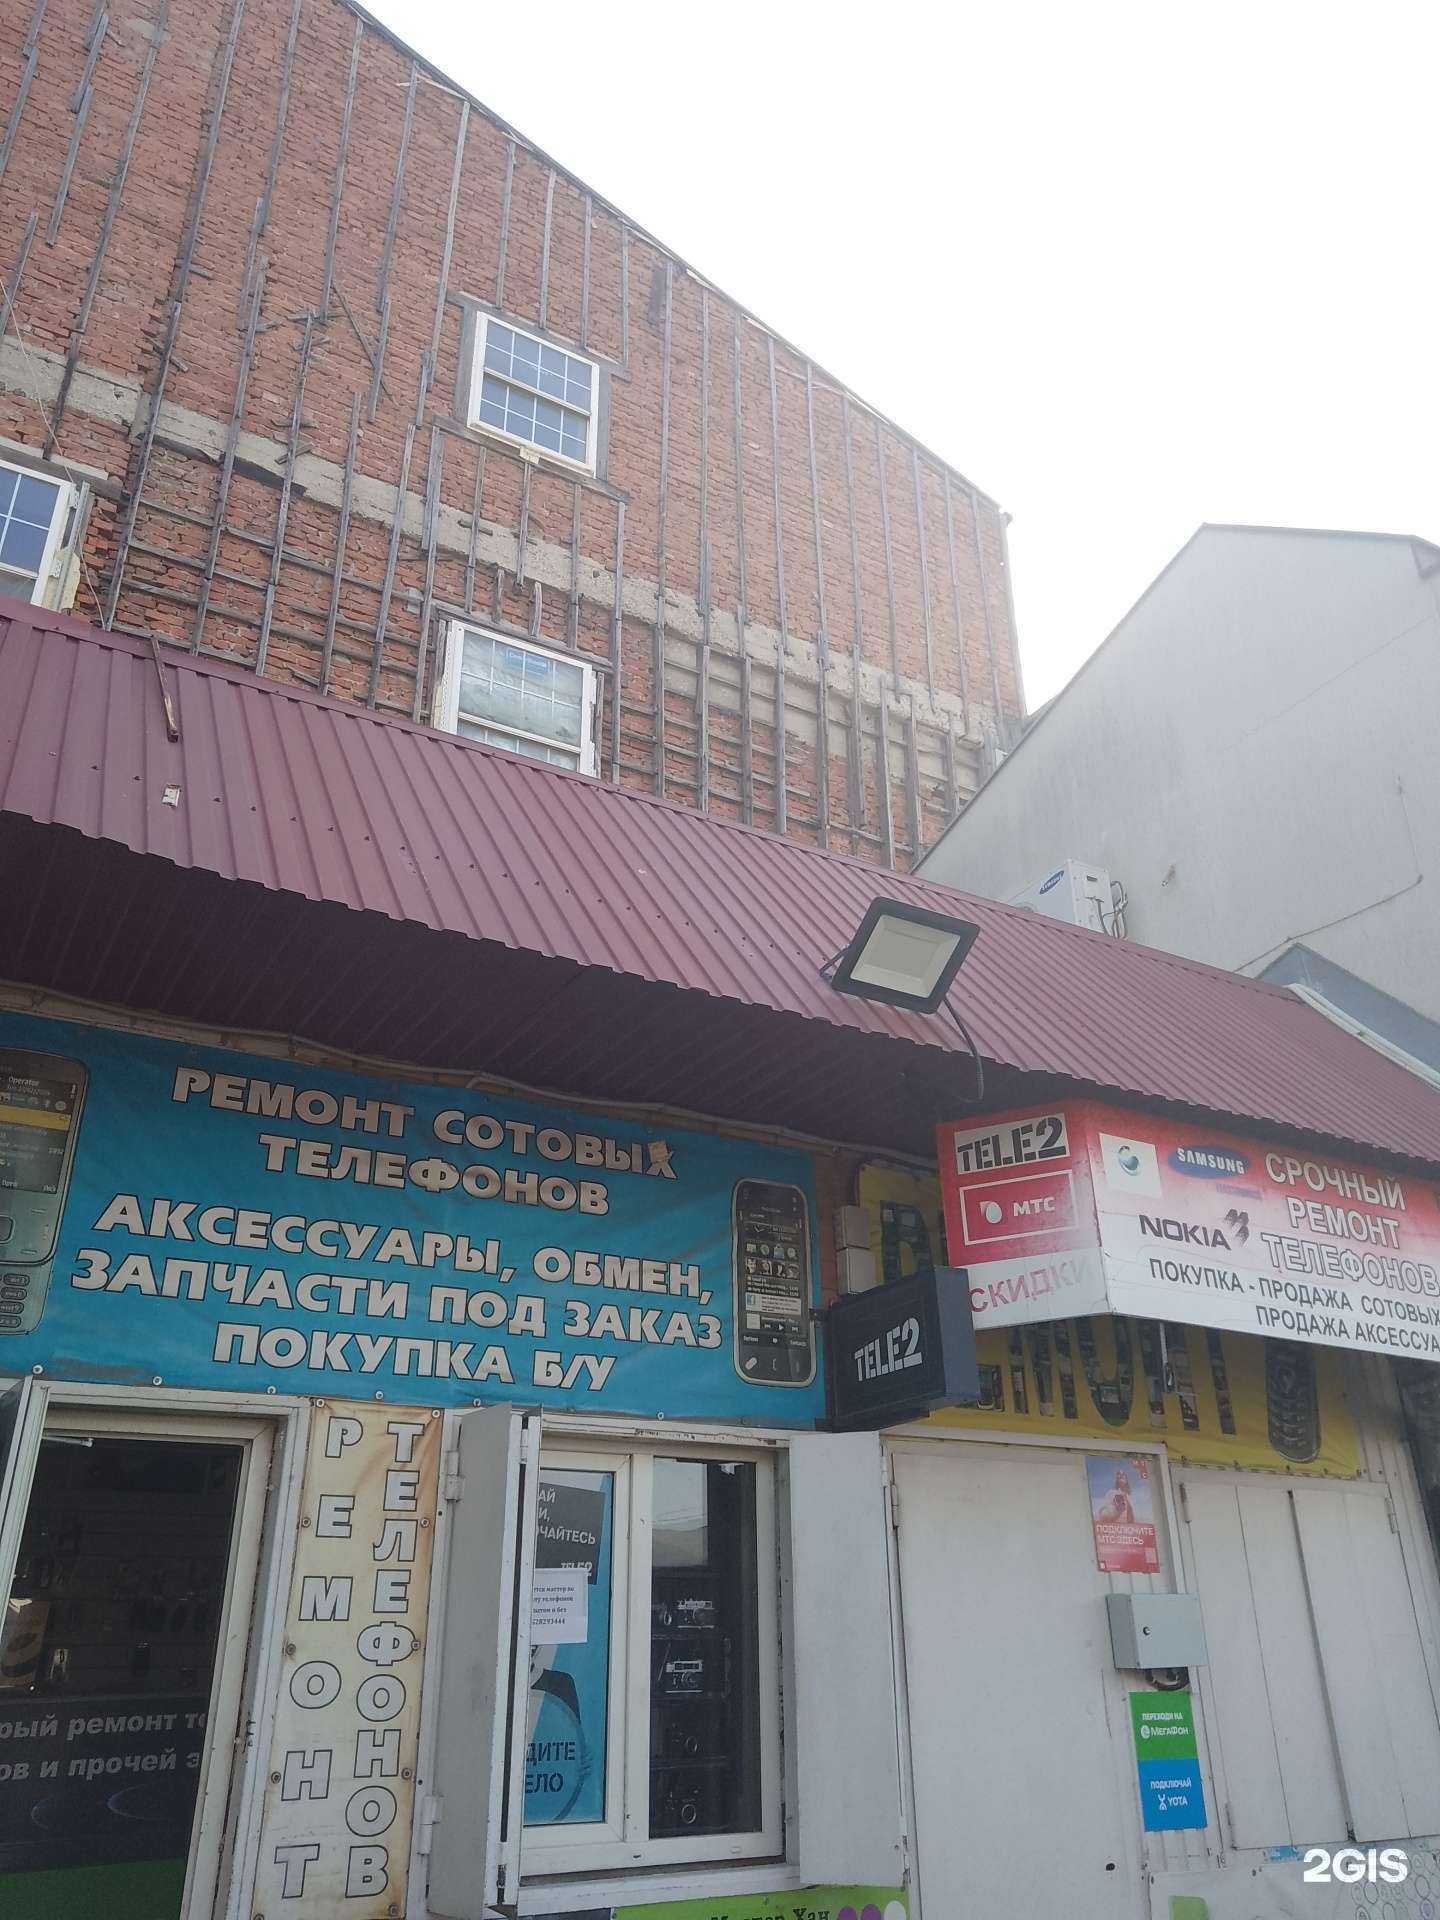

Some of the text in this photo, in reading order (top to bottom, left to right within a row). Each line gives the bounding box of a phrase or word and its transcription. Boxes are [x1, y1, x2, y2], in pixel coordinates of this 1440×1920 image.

[172, 1066, 678, 1180] РЕМОНТ СОТОВЫХ
[957, 1116, 1067, 1172] TELE2
[259, 1134, 609, 1216] ТЕЛЕФОНОВ
[1177, 1147, 1246, 1175] SAMSUNG
[1265, 1152, 1406, 1212] СРОЧНЫЙ
[1013, 1196, 1056, 1217] МТС
[1139, 1214, 1232, 1251] NOKIA
[1286, 1195, 1400, 1249] РЕМОНТ
[93, 1193, 714, 1305] АКСЕССУАРЫ, ОБМЕН,
[1260, 1232, 1440, 1297] ТЕЛЕФОНОВ
[71, 1249, 408, 1320] ЗАПЧАСТИ
[428, 1285, 548, 1338] ПОД
[564, 1300, 723, 1349] ЗАКАЗ
[968, 1258, 1086, 1312] СКИДКИ
[1149, 1258, 1244, 1294] ПОКУПКА
[1258, 1277, 1353, 1312] ПРОДАЖА
[1256, 1305, 1350, 1339] ПРОДАЖА
[213, 1321, 616, 1392] ПОКУПКА Б/У
[854, 1317, 924, 1382] TELE2
[538, 1525, 596, 1545] ЧАЙТЕСЬ
[274, 1416, 363, 1899] РЕМОНТ
[344, 1421, 424, 1899] ТЕЛЕФОНОВ
[66, 1713, 177, 1740] ремонт
[39, 1761, 60, 1778] и
[68, 1747, 177, 1781] прочей
[1150, 1777, 1191, 1789] ПОДКЛЮЧАЙ
[1168, 1796, 1188, 1806] YOTA
